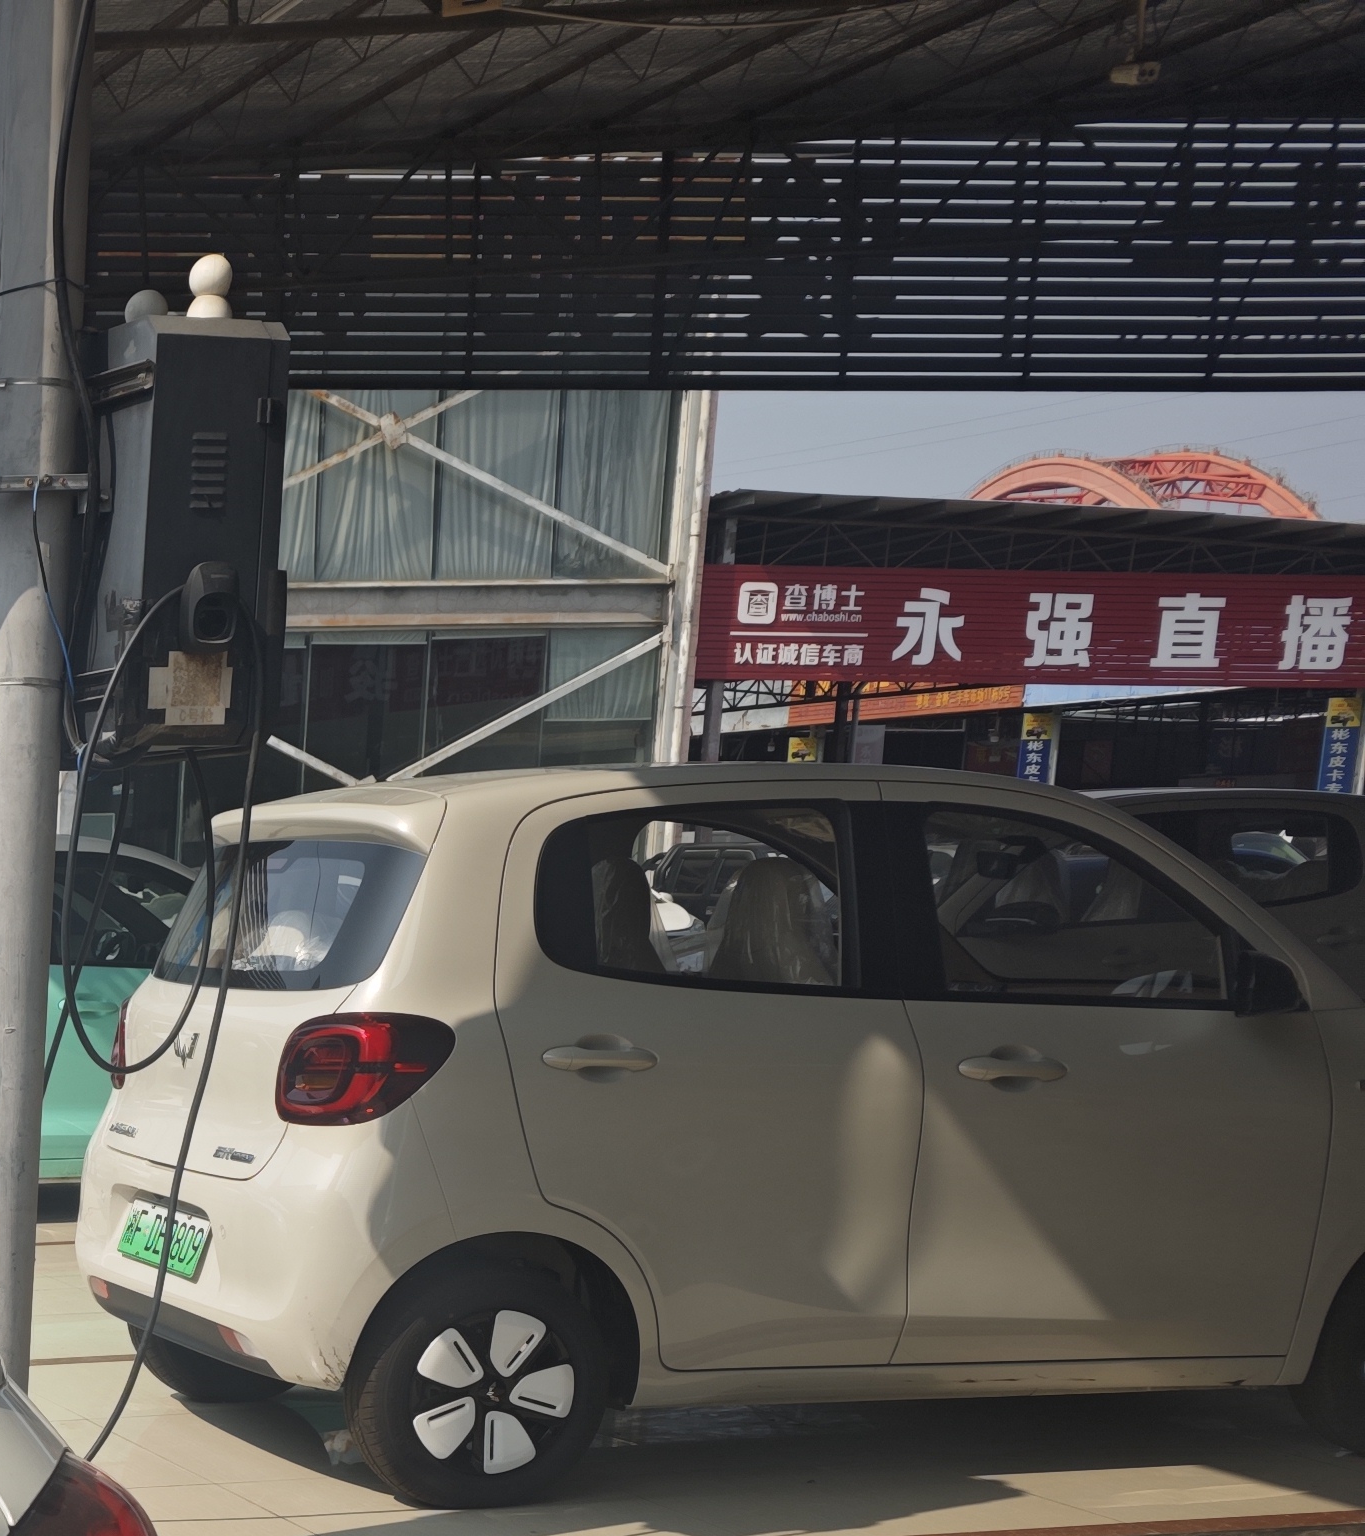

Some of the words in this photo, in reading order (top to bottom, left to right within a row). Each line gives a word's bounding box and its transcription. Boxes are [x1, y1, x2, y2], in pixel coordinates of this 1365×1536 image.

[782, 583, 866, 611] 查博士
[780, 611, 862, 623] www.chaboshi.cn
[733, 642, 865, 666] 认证诚信车商
